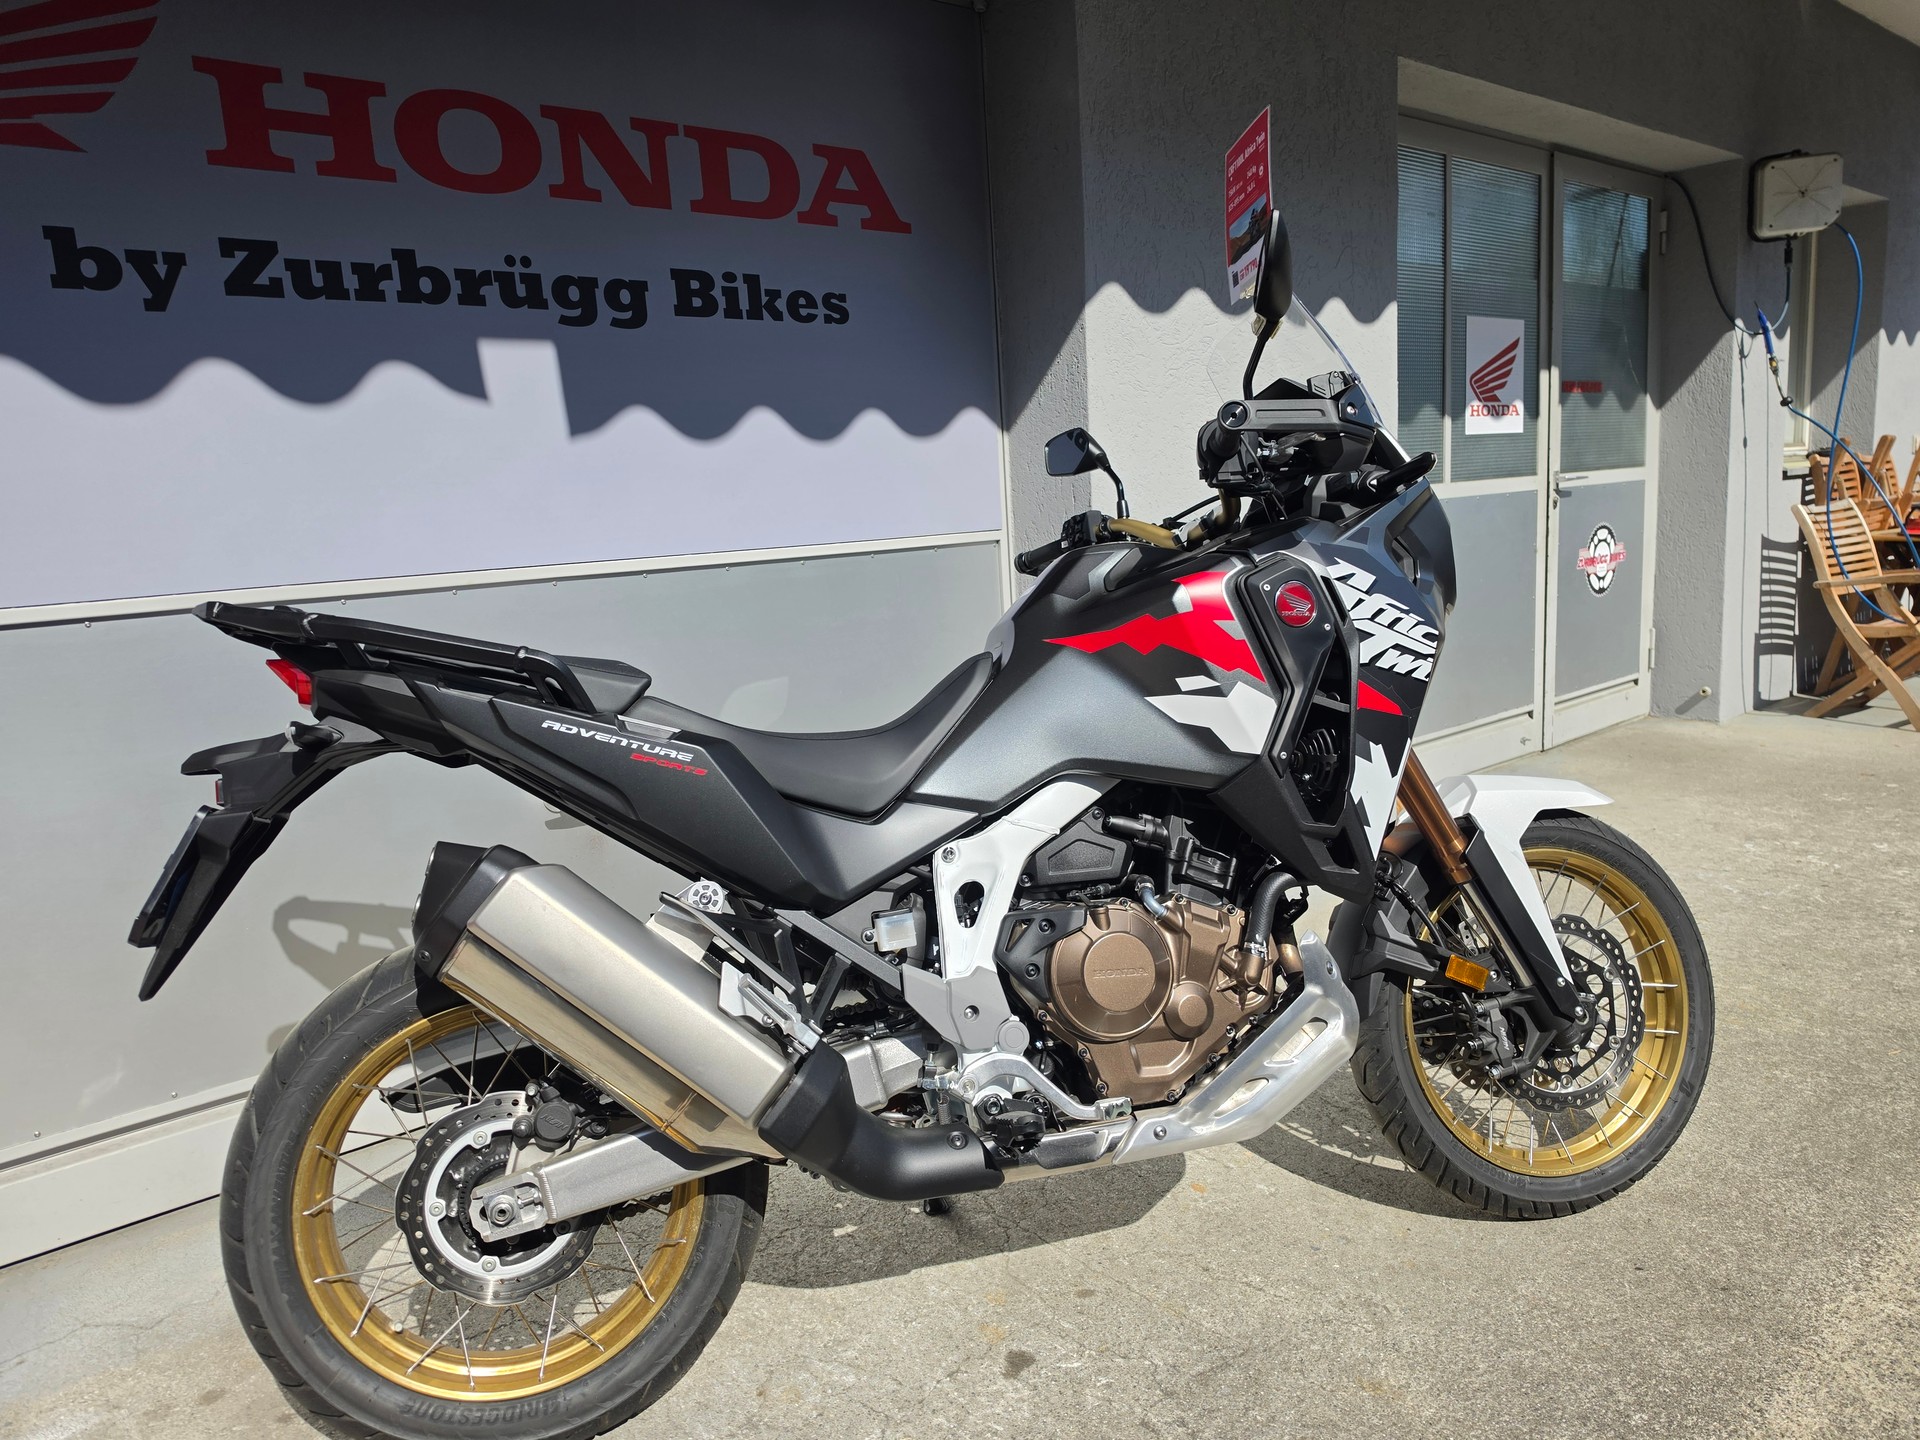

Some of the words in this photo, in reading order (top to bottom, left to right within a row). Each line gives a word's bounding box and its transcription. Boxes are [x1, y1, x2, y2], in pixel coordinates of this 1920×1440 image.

[191, 55, 912, 234] HONDA
[42, 225, 186, 312] by
[218, 237, 648, 330] Zurbrügg
[670, 268, 850, 325] Bikes
[1470, 404, 1520, 417] HONDA
[1326, 557, 1439, 649] Afric
[1352, 619, 1437, 682] Twi
[541, 720, 694, 762] ADVENTURE
[630, 753, 708, 776] SPORTS
[1092, 967, 1149, 979] HONDA
